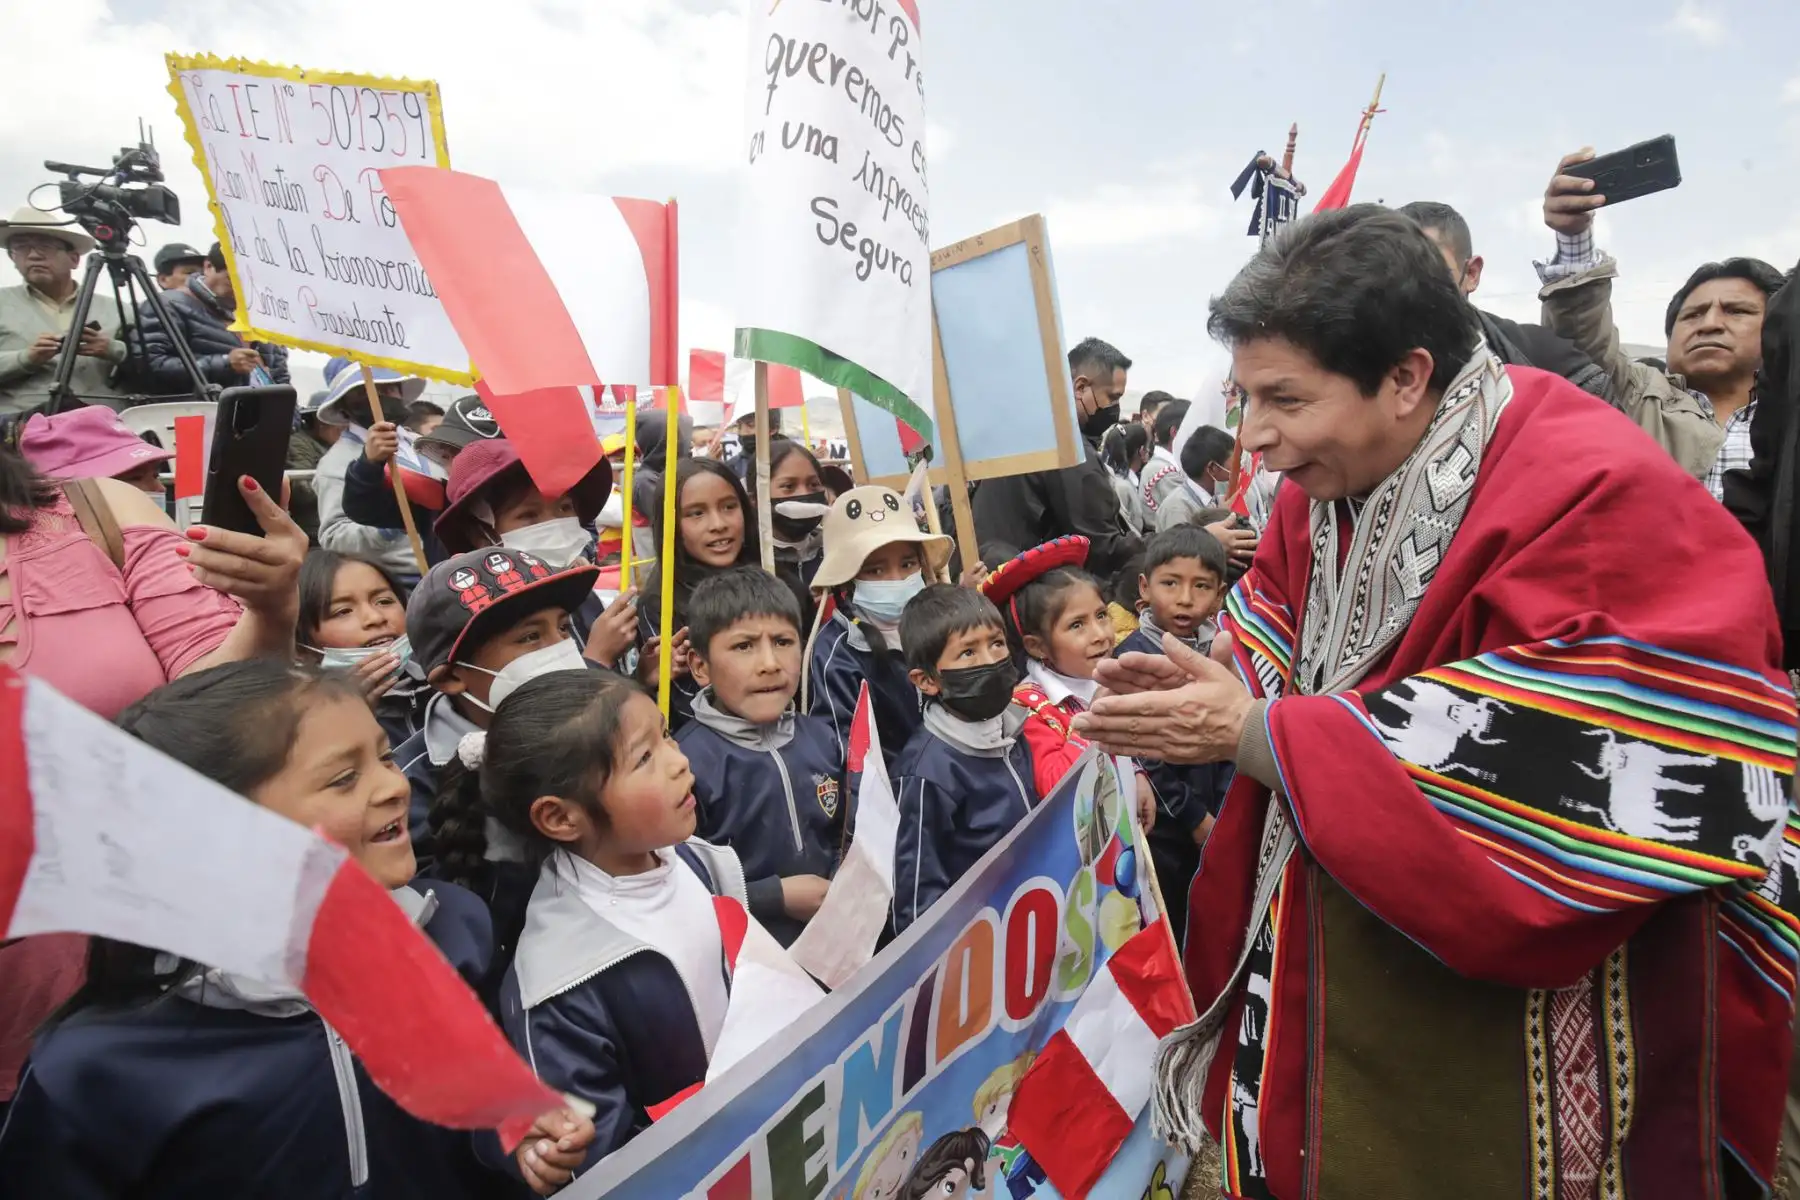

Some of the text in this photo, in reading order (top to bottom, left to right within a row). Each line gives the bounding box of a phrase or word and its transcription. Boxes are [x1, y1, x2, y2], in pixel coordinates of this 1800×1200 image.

[764, 33, 905, 147] queremos
[888, 16, 924, 97] Pre
[180, 74, 229, 133] La
[226, 84, 270, 140] IE
[308, 85, 427, 159] 501359
[781, 121, 838, 164] una
[208, 142, 250, 201] San
[240, 148, 309, 213] Martin
[313, 164, 360, 223] De
[221, 202, 250, 257] le
[252, 216, 280, 267] da
[278, 218, 314, 276] la
[811, 196, 912, 287] Segura
[298, 286, 411, 349] Presidente
